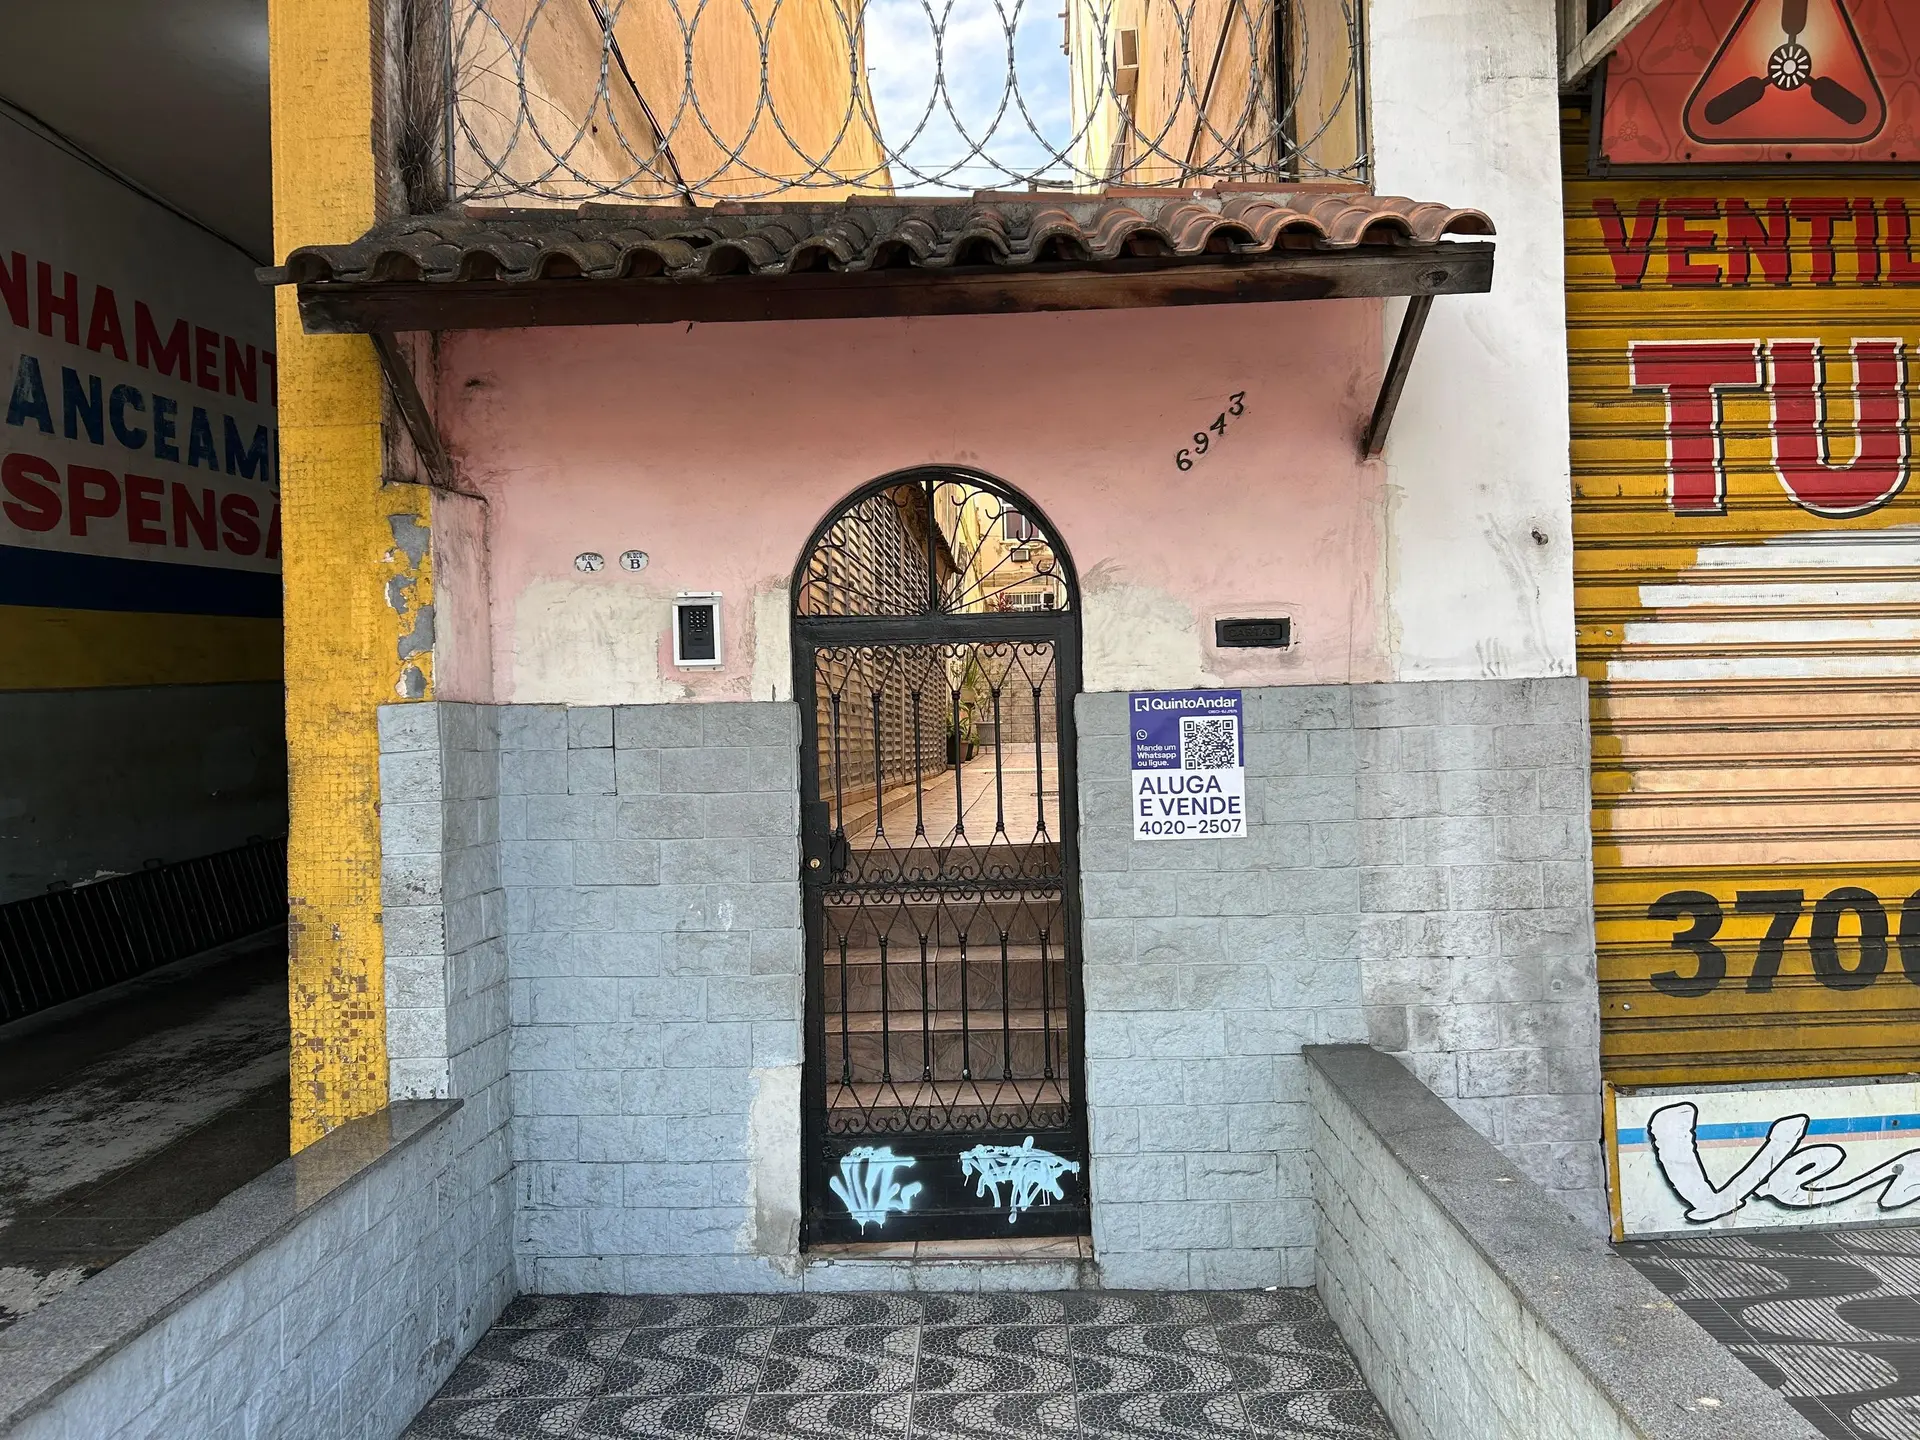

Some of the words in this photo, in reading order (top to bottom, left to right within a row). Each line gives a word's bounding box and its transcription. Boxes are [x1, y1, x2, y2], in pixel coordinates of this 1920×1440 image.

[1592, 197, 1920, 289] VENTIL
[6, 353, 280, 485] ANCEAM
[1176, 391, 1245, 471] 6943
[1626, 337, 1920, 520] TU
[583, 561, 595, 572] A
[630, 559, 641, 570] B
[1228, 627, 1276, 637] CARTAS
[1151, 696, 1238, 710] QuintoAndar
[1137, 752, 1177, 760] Whatsapp
[1149, 759, 1170, 768] ligue.
[1139, 775, 1222, 795] ALUGA
[1140, 798, 1153, 816] E
[1159, 796, 1241, 816] VENDE
[1139, 818, 1241, 835] 4020-2507
